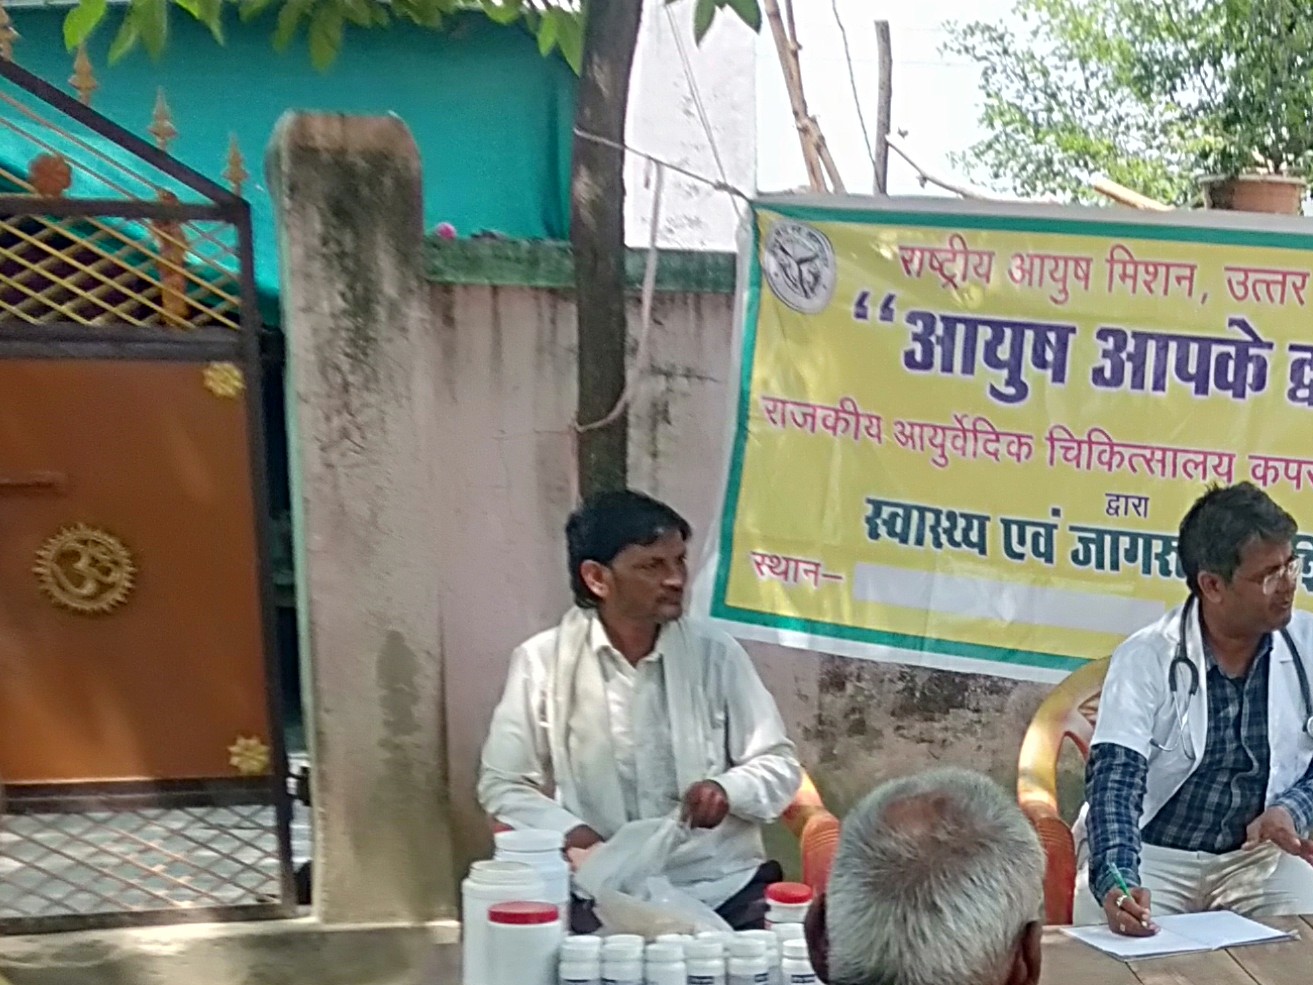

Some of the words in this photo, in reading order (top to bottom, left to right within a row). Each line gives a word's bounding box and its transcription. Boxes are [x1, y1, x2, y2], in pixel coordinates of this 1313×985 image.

[899, 235, 994, 289] राष्ट्रीय
[1008, 254, 1093, 302] आयुष
[1106, 244, 1210, 304] मिशन,
[1224, 266, 1310, 306] उत्तर
[1092, 317, 1273, 401] आपके
[763, 397, 883, 444] राजकीय
[1045, 427, 1236, 488] चिकित्सालय
[864, 497, 990, 556] स्वास्थ्य
[1000, 507, 1061, 564] एवं
[1105, 492, 1150, 519] द्वारा
